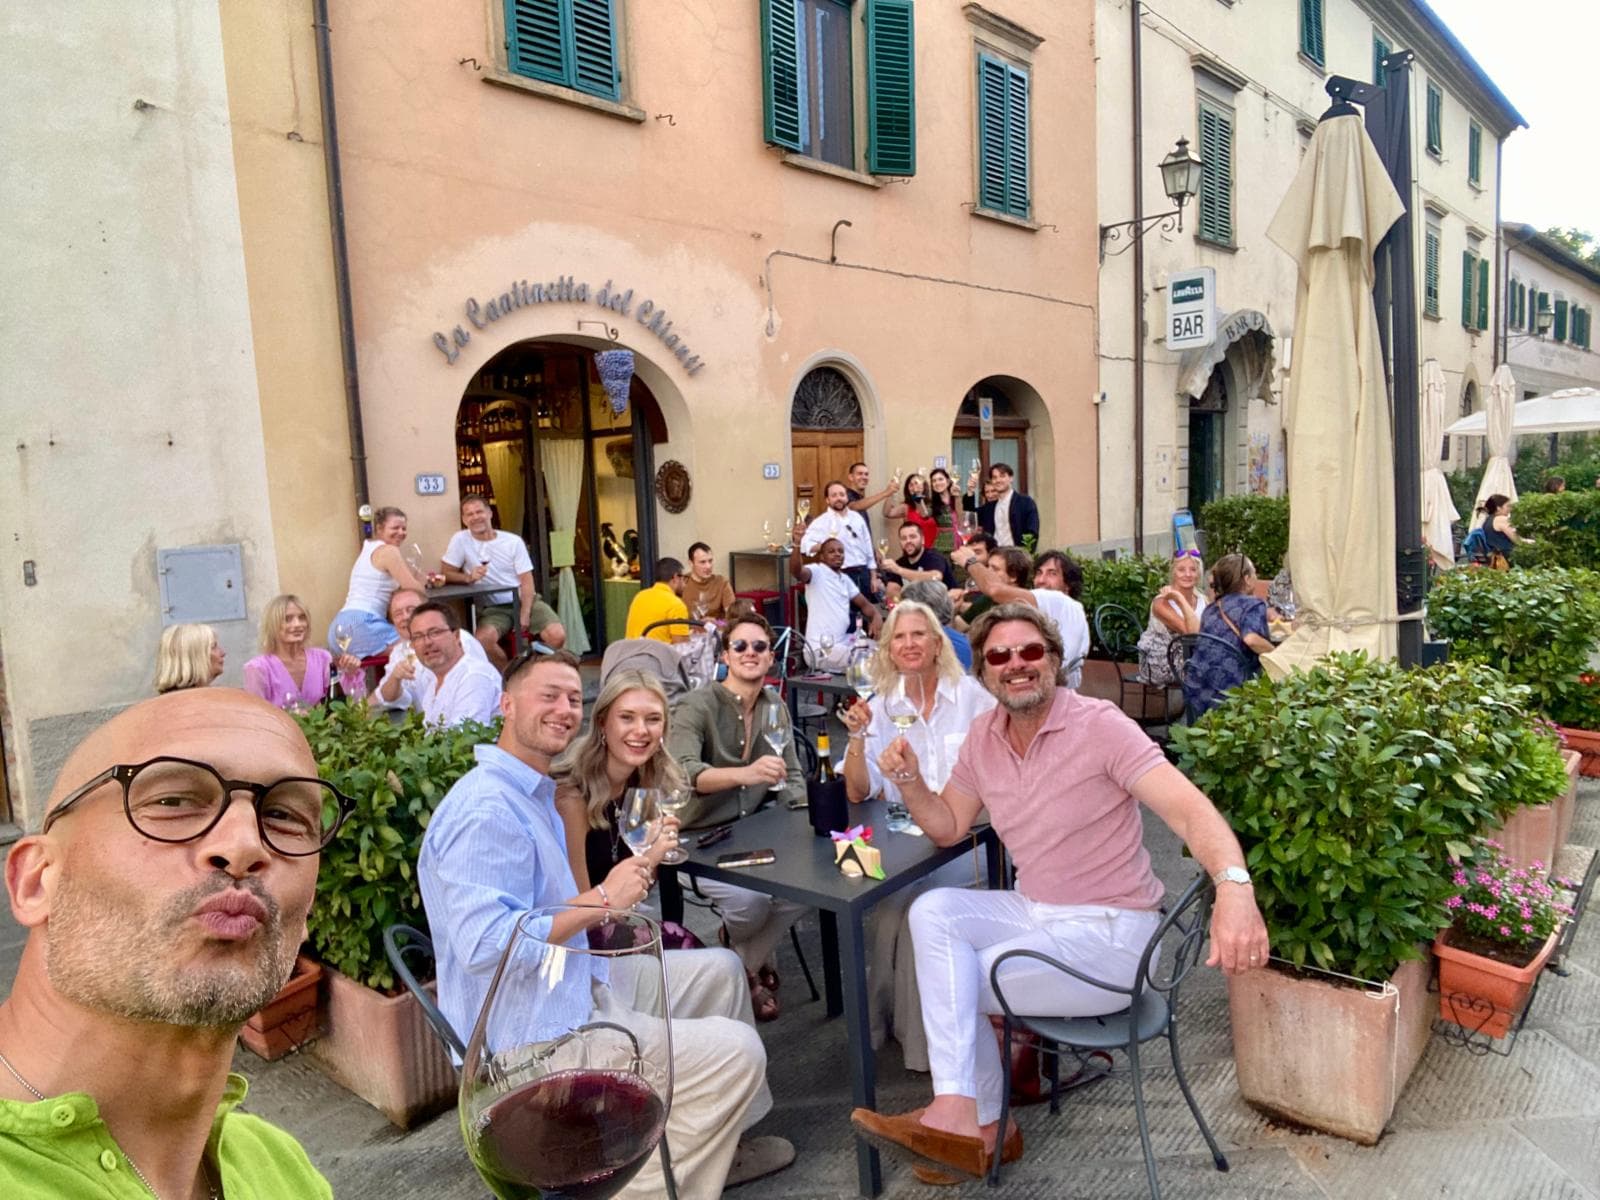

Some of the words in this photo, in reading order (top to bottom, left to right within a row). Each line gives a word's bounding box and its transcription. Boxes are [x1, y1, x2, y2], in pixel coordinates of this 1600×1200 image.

[433, 324, 470, 365] La
[466, 275, 590, 330] Cantinetta
[597, 279, 633, 316] del
[636, 299, 705, 377] Chianti
[1173, 314, 1204, 337] BAR
[1225, 315, 1249, 340] BAR
[423, 478, 440, 491] 33
